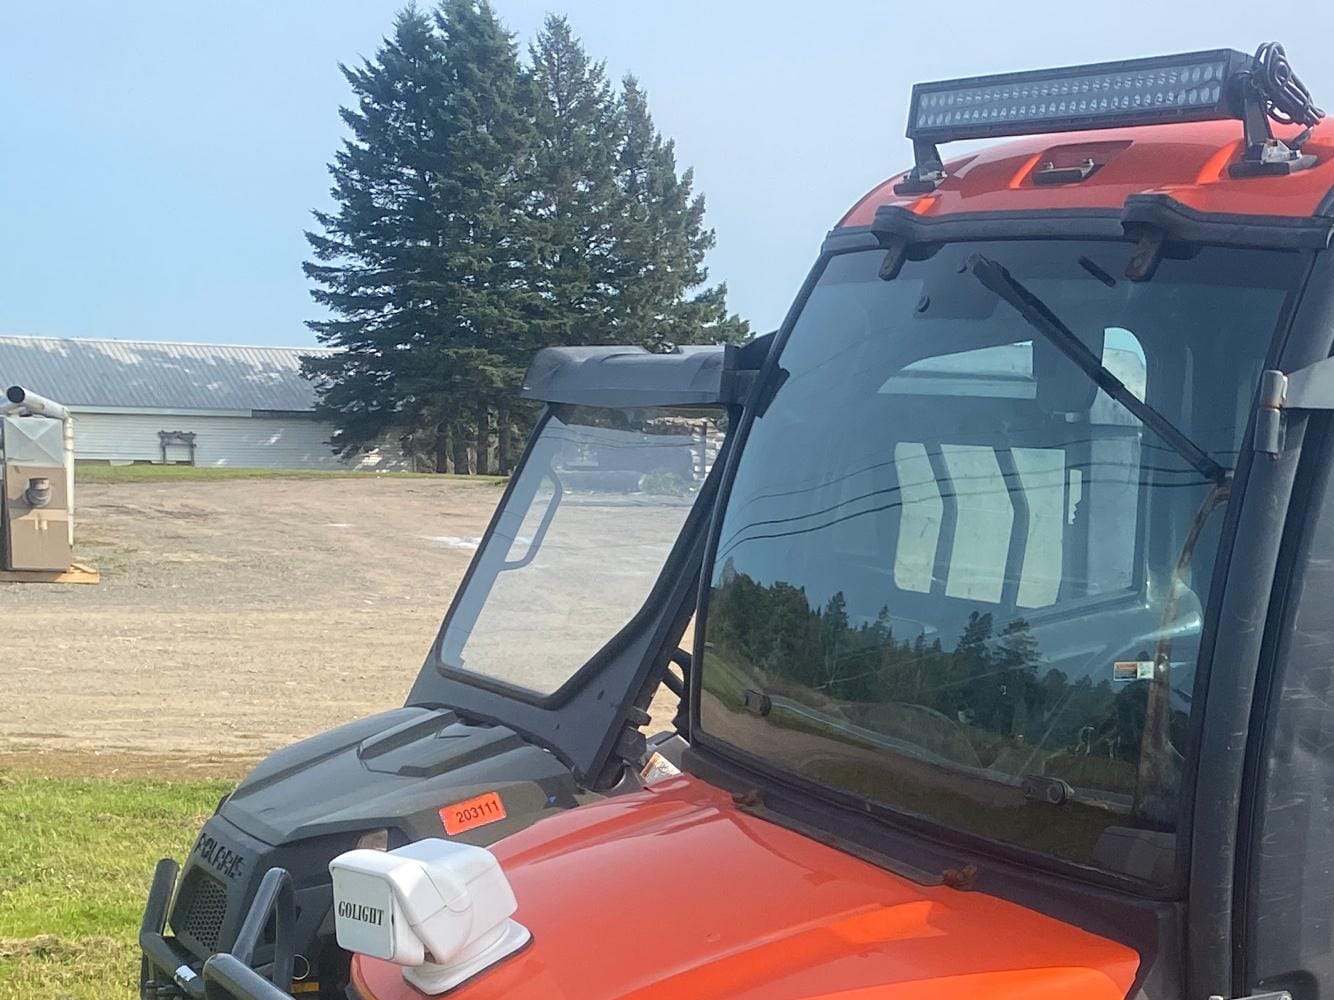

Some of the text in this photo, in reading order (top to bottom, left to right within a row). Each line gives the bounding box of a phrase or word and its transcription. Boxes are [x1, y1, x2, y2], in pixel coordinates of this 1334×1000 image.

[455, 799, 500, 824] 203111
[194, 832, 244, 879] POLARIS
[338, 900, 385, 926] GOLIGHT
